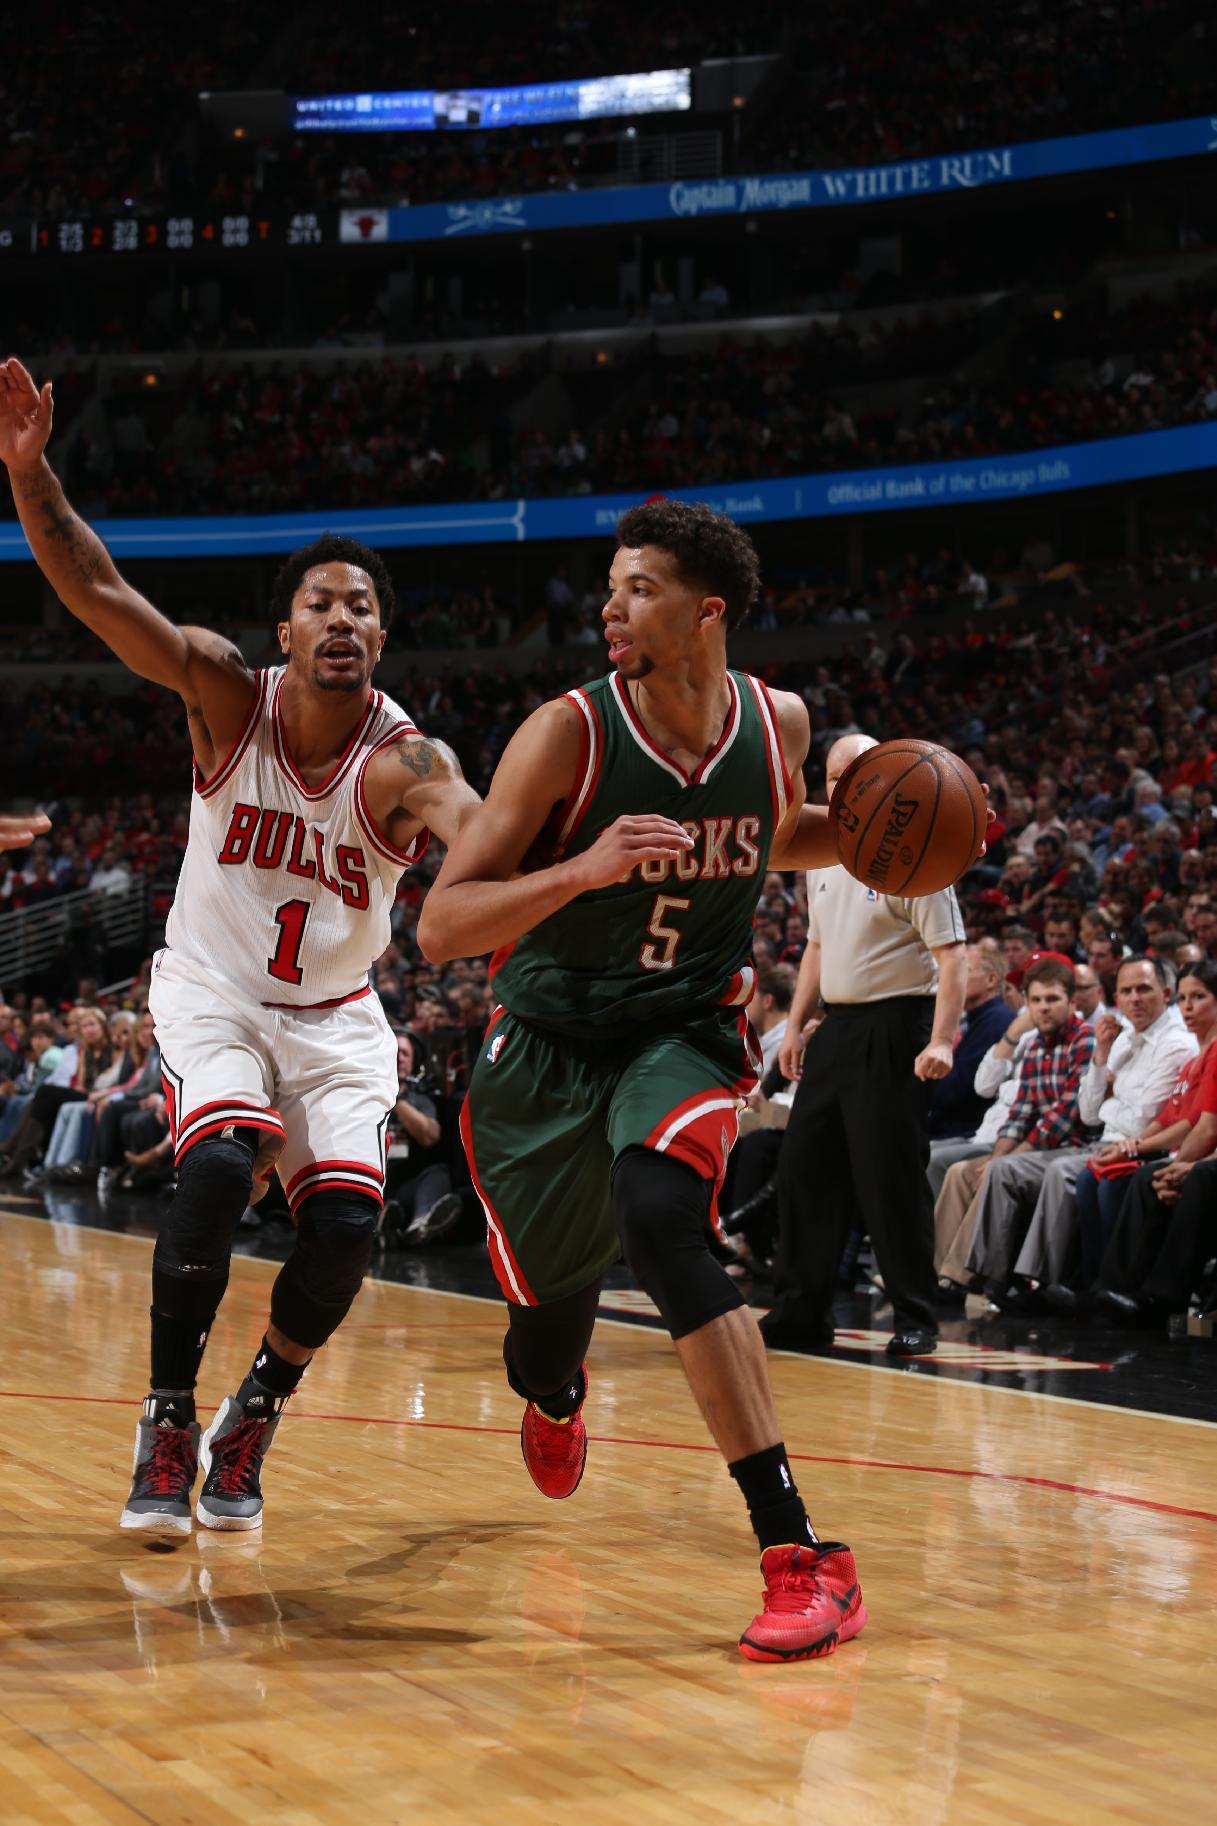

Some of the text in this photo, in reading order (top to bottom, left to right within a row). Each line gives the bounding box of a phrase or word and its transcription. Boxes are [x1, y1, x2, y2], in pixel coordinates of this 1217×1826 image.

[669, 148, 1013, 217] Captain Morgan WHITE RUM
[89, 225, 104, 246] 2
[144, 223, 159, 244] 3
[201, 223, 215, 241] 4
[257, 219, 271, 240] T
[828, 459, 1069, 504] Official Bank of the Chicago Bulls
[218, 802, 370, 911] BULLS
[612, 815, 760, 884] CKS
[266, 896, 313, 986] 1
[640, 893, 691, 971] 5
